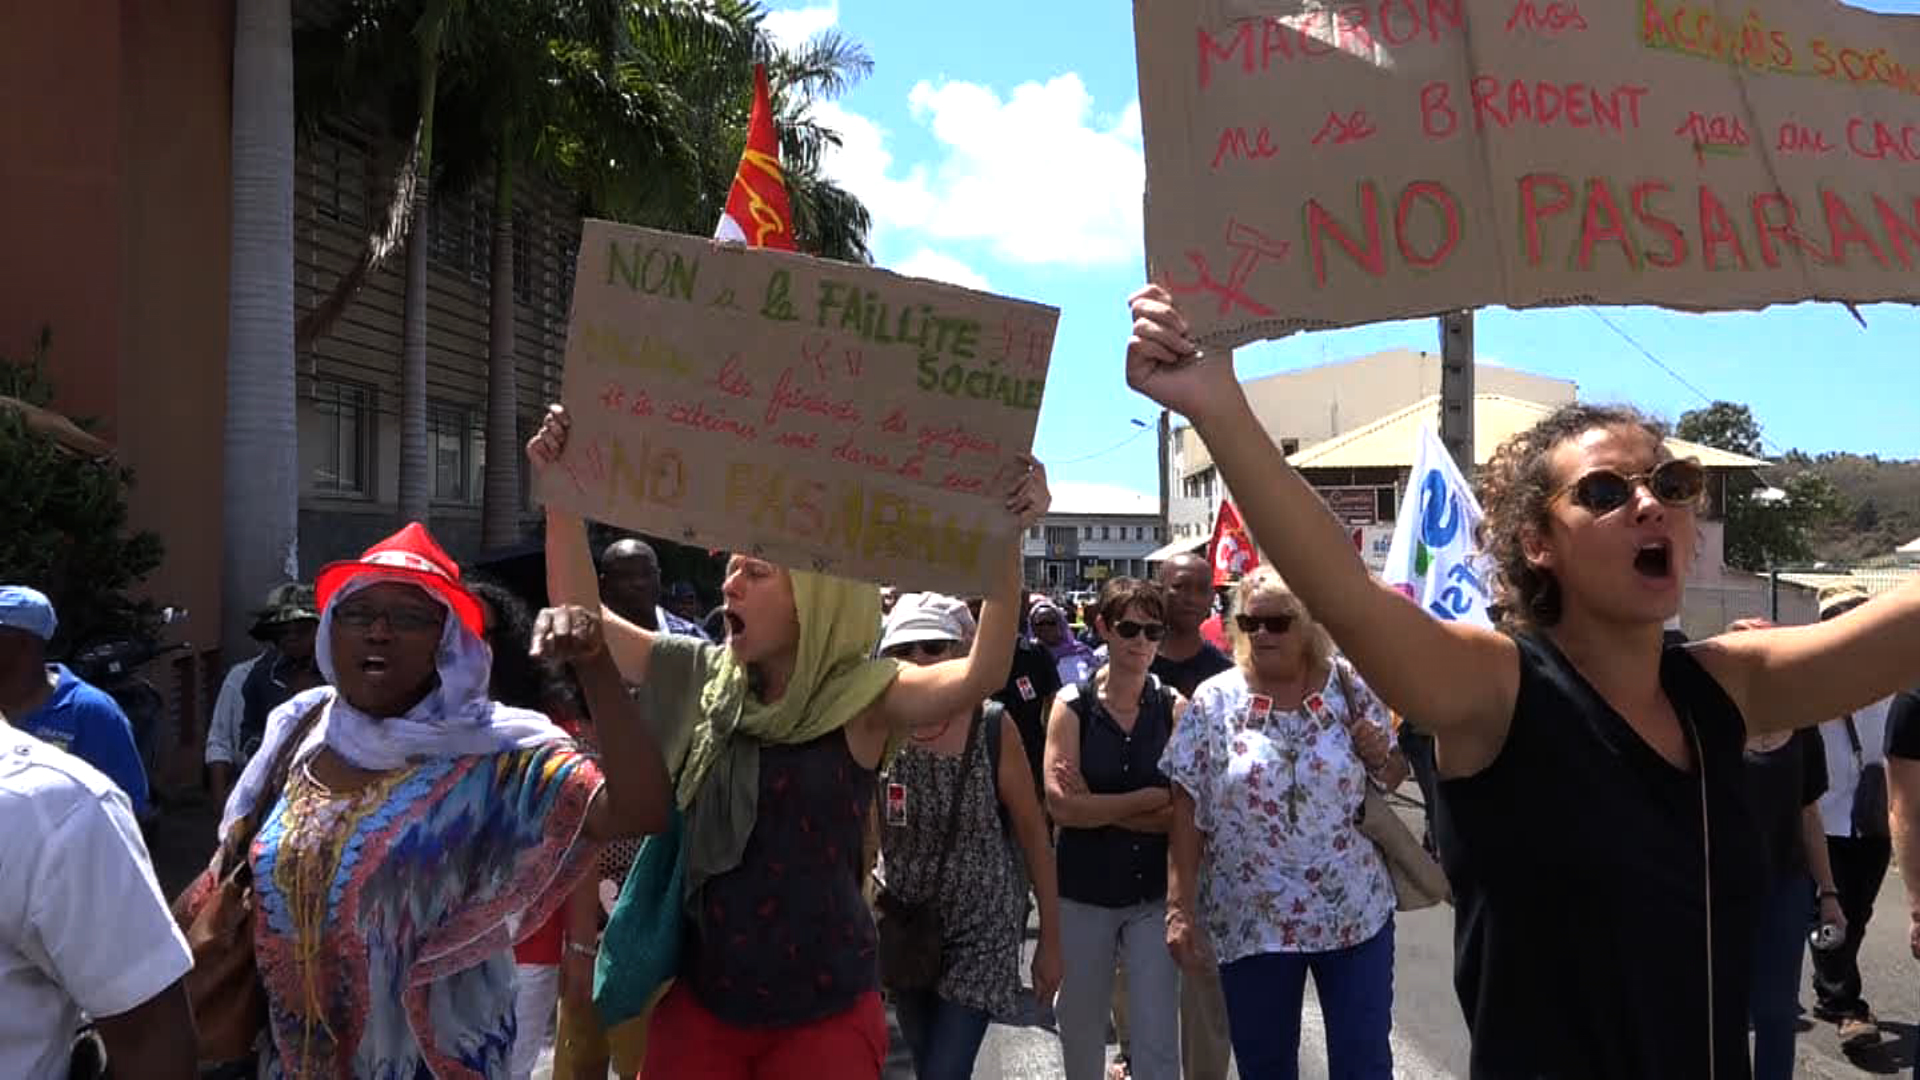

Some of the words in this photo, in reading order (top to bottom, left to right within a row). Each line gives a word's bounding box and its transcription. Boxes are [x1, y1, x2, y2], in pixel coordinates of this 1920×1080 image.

[1311, 109, 1377, 144] se
[1420, 75, 1650, 142] BRADENT
[1675, 111, 1750, 168] pas
[1778, 121, 1835, 152] au
[1305, 178, 1464, 289] NO
[606, 241, 700, 301] NON
[760, 268, 800, 322] la
[831, 438, 890, 466] dans
